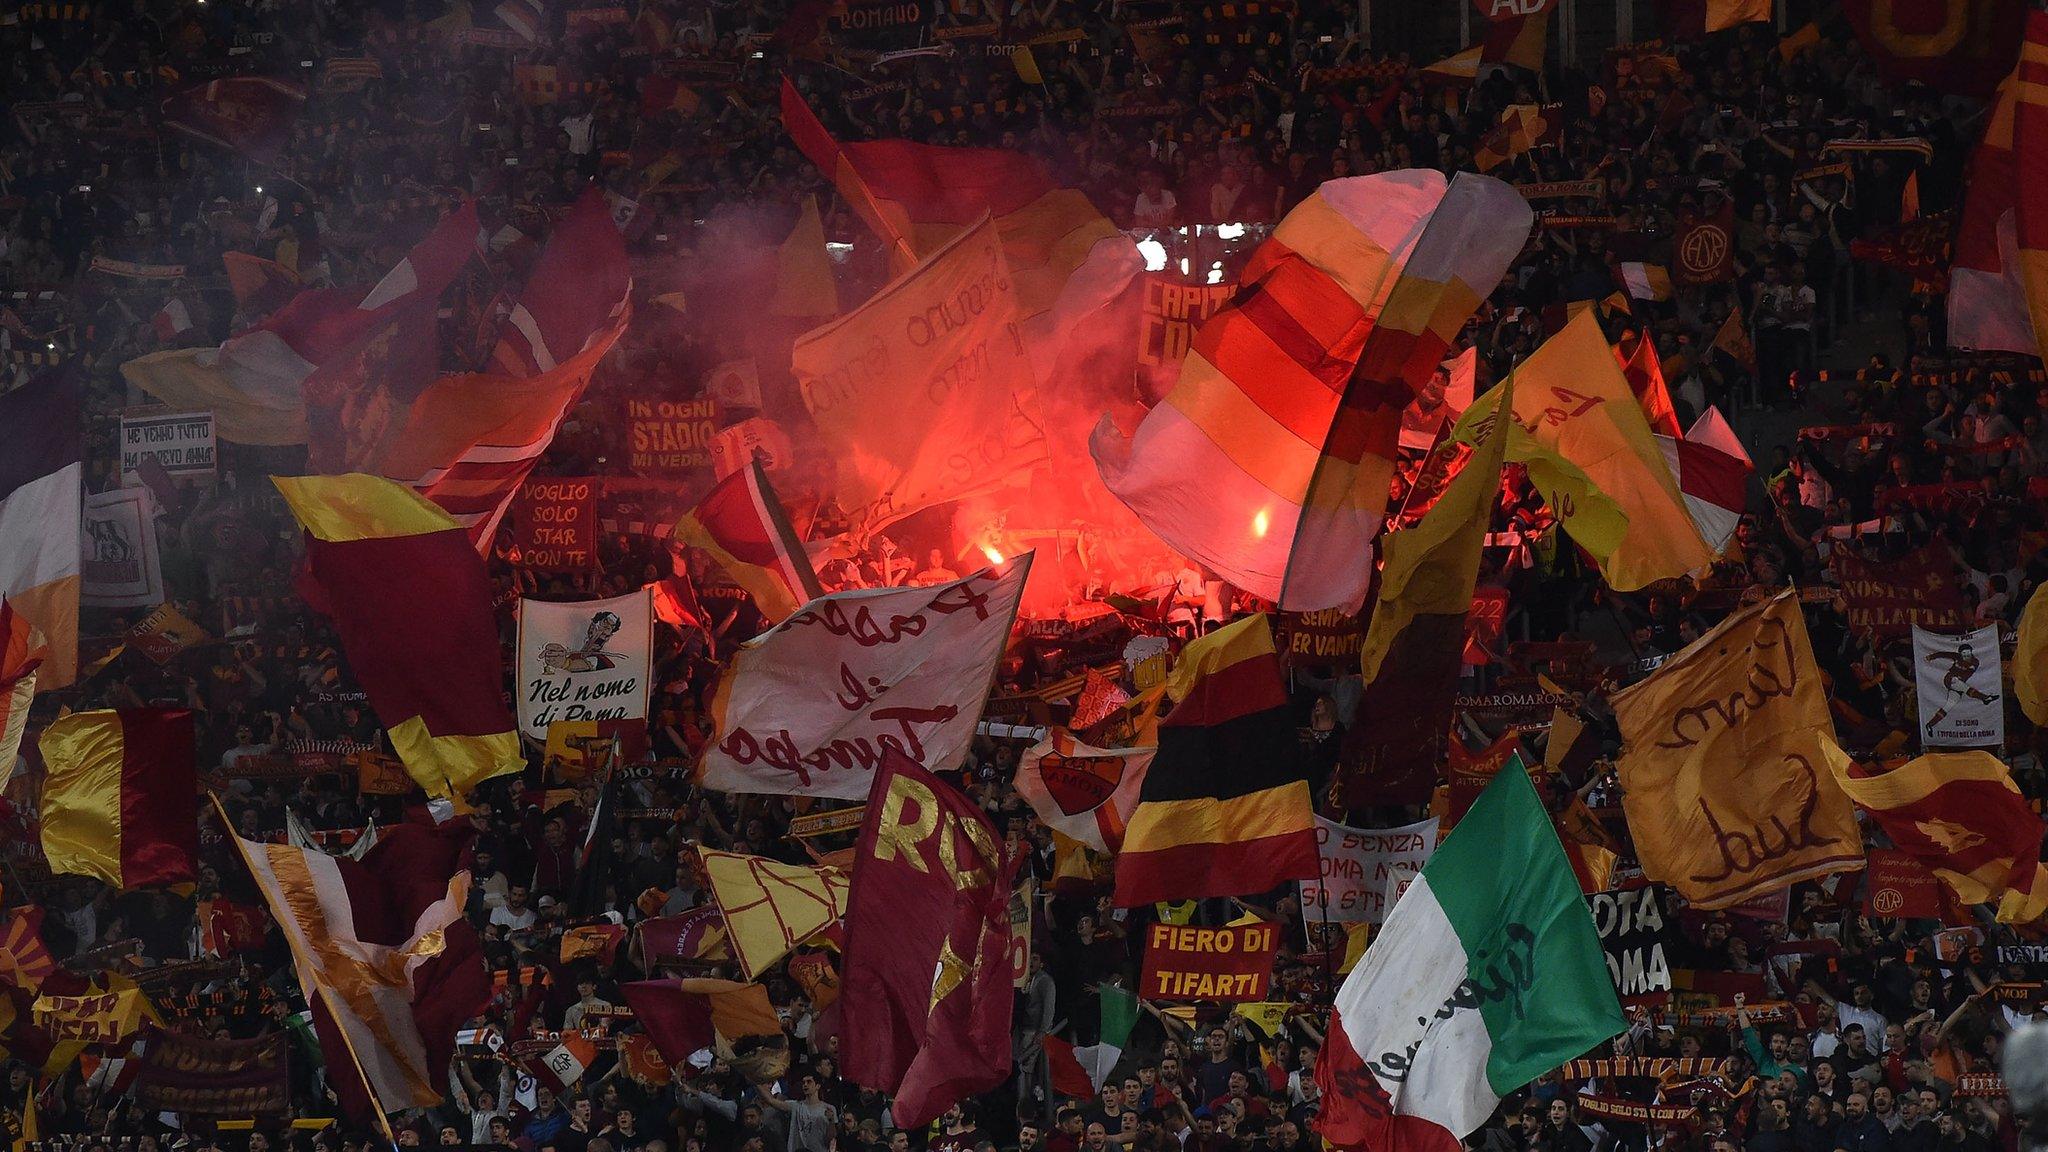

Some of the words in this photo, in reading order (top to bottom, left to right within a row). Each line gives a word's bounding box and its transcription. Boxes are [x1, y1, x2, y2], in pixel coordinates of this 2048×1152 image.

[629, 400, 652, 418] IN
[659, 400, 715, 418] OGNI
[634, 420, 716, 452] STADIO
[633, 453, 652, 467] MI
[659, 453, 708, 468] VEDR
[524, 484, 589, 502] VOGLIO
[532, 507, 578, 523] SOLO
[533, 529, 577, 546] STAR
[524, 549, 562, 567] CON
[566, 549, 587, 567] TE
[530, 679, 571, 705] Nel
[576, 677, 636, 702] nome
[532, 706, 558, 728] di
[1342, 833, 1425, 852] SENZA
[1320, 857, 1365, 880] OMA
[1152, 926, 1236, 952] FIERO
[1242, 926, 1272, 952] DI
[1606, 943, 1672, 996] MA
[1156, 969, 1259, 997] TIFARTI
[1578, 1097, 1609, 1113] VOGLIO
[1610, 1104, 1632, 1117] SOLO
[1657, 1109, 1675, 1120] CON
